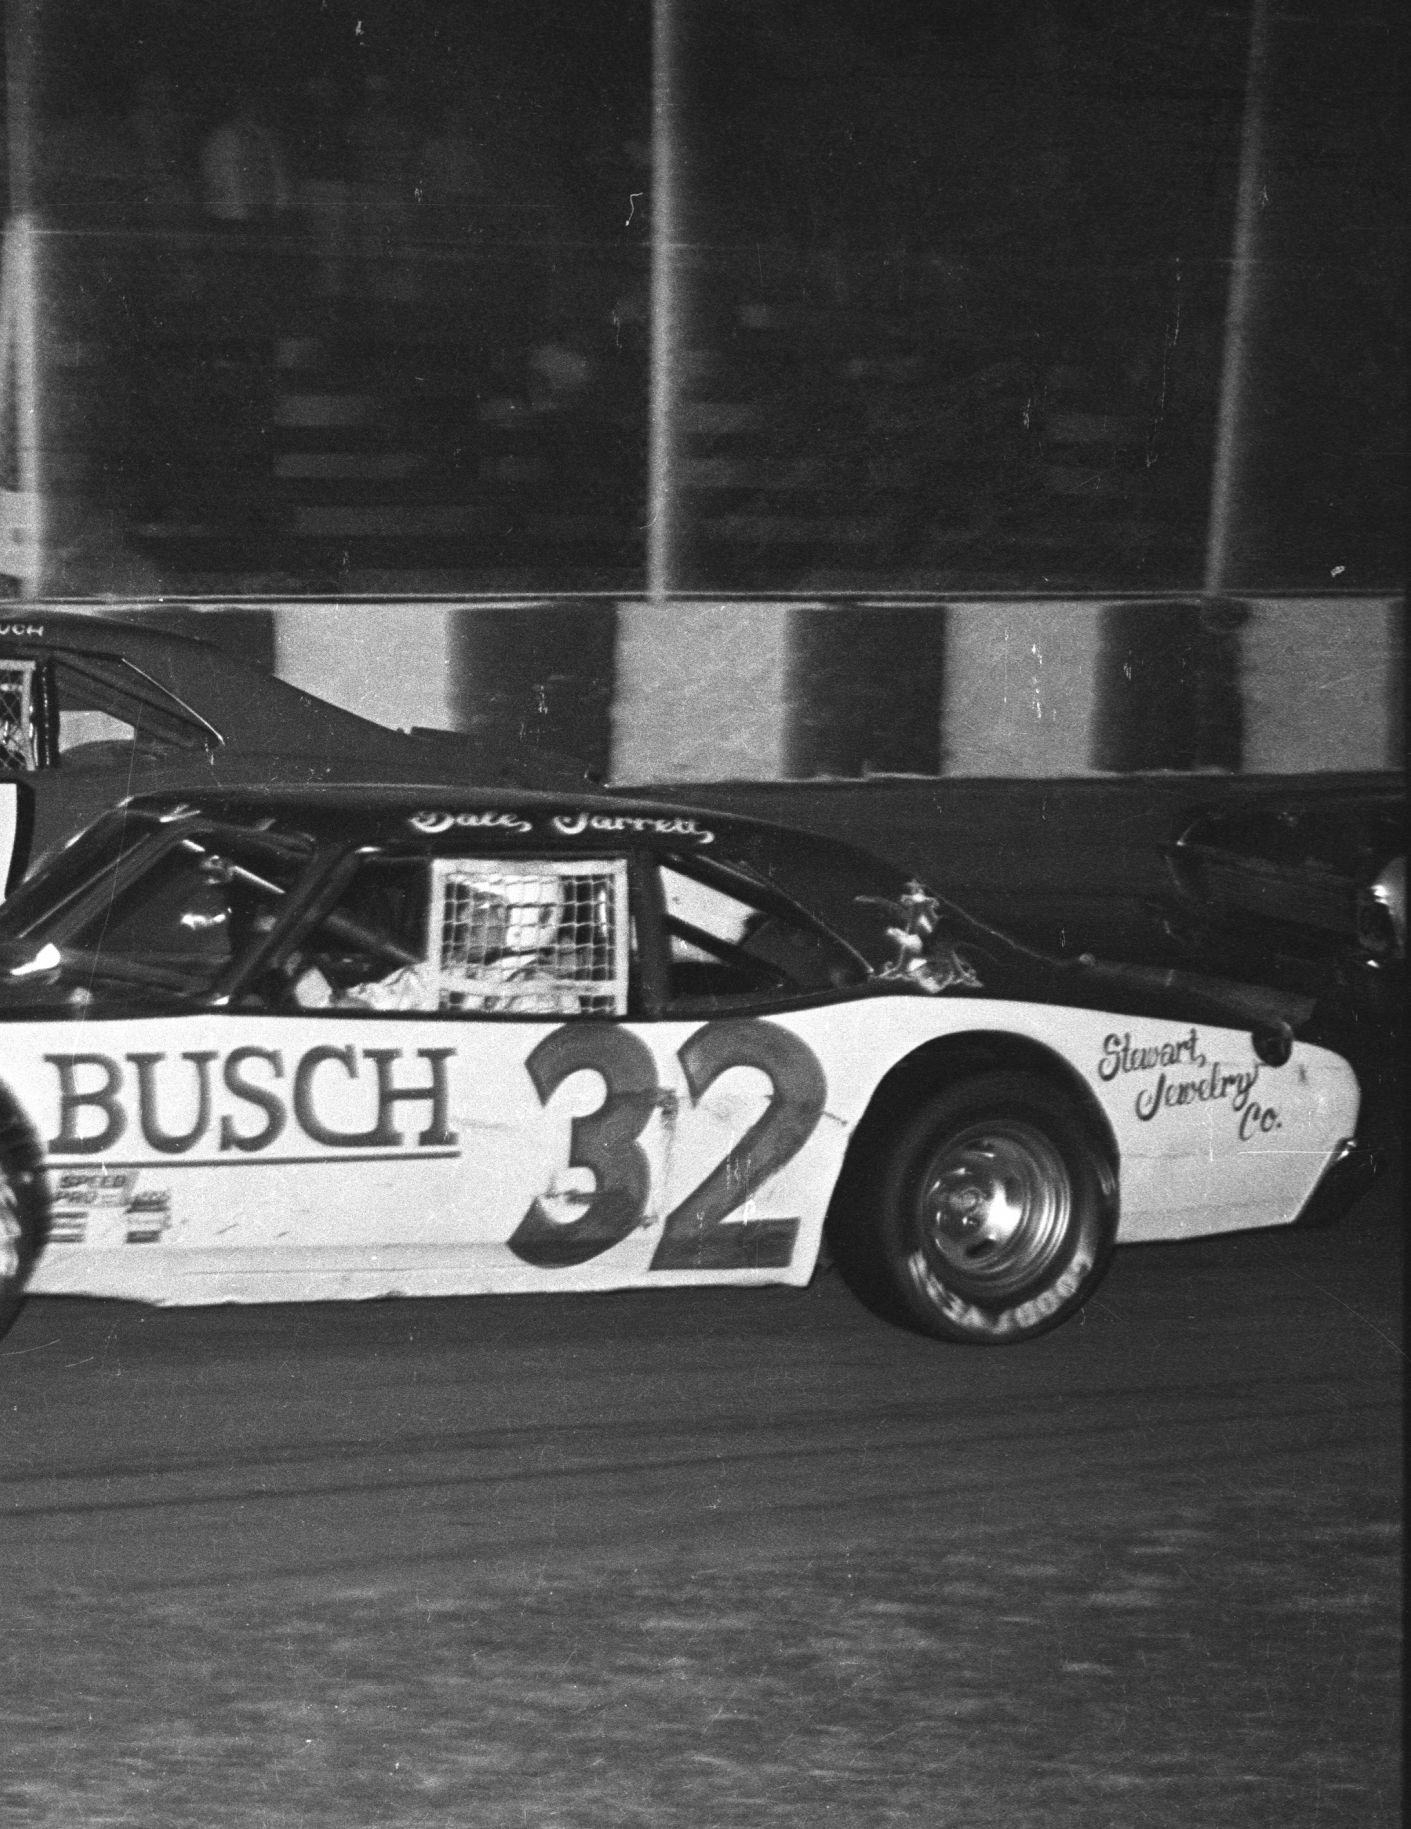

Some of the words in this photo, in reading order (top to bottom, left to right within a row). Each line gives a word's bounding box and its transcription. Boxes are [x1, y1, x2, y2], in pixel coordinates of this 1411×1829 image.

[42, 1043, 460, 1155] BUSCH
[1135, 1061, 1259, 1122] Jewelry
[1239, 1101, 1283, 1141] Co.
[504, 1018, 828, 1272] 32
